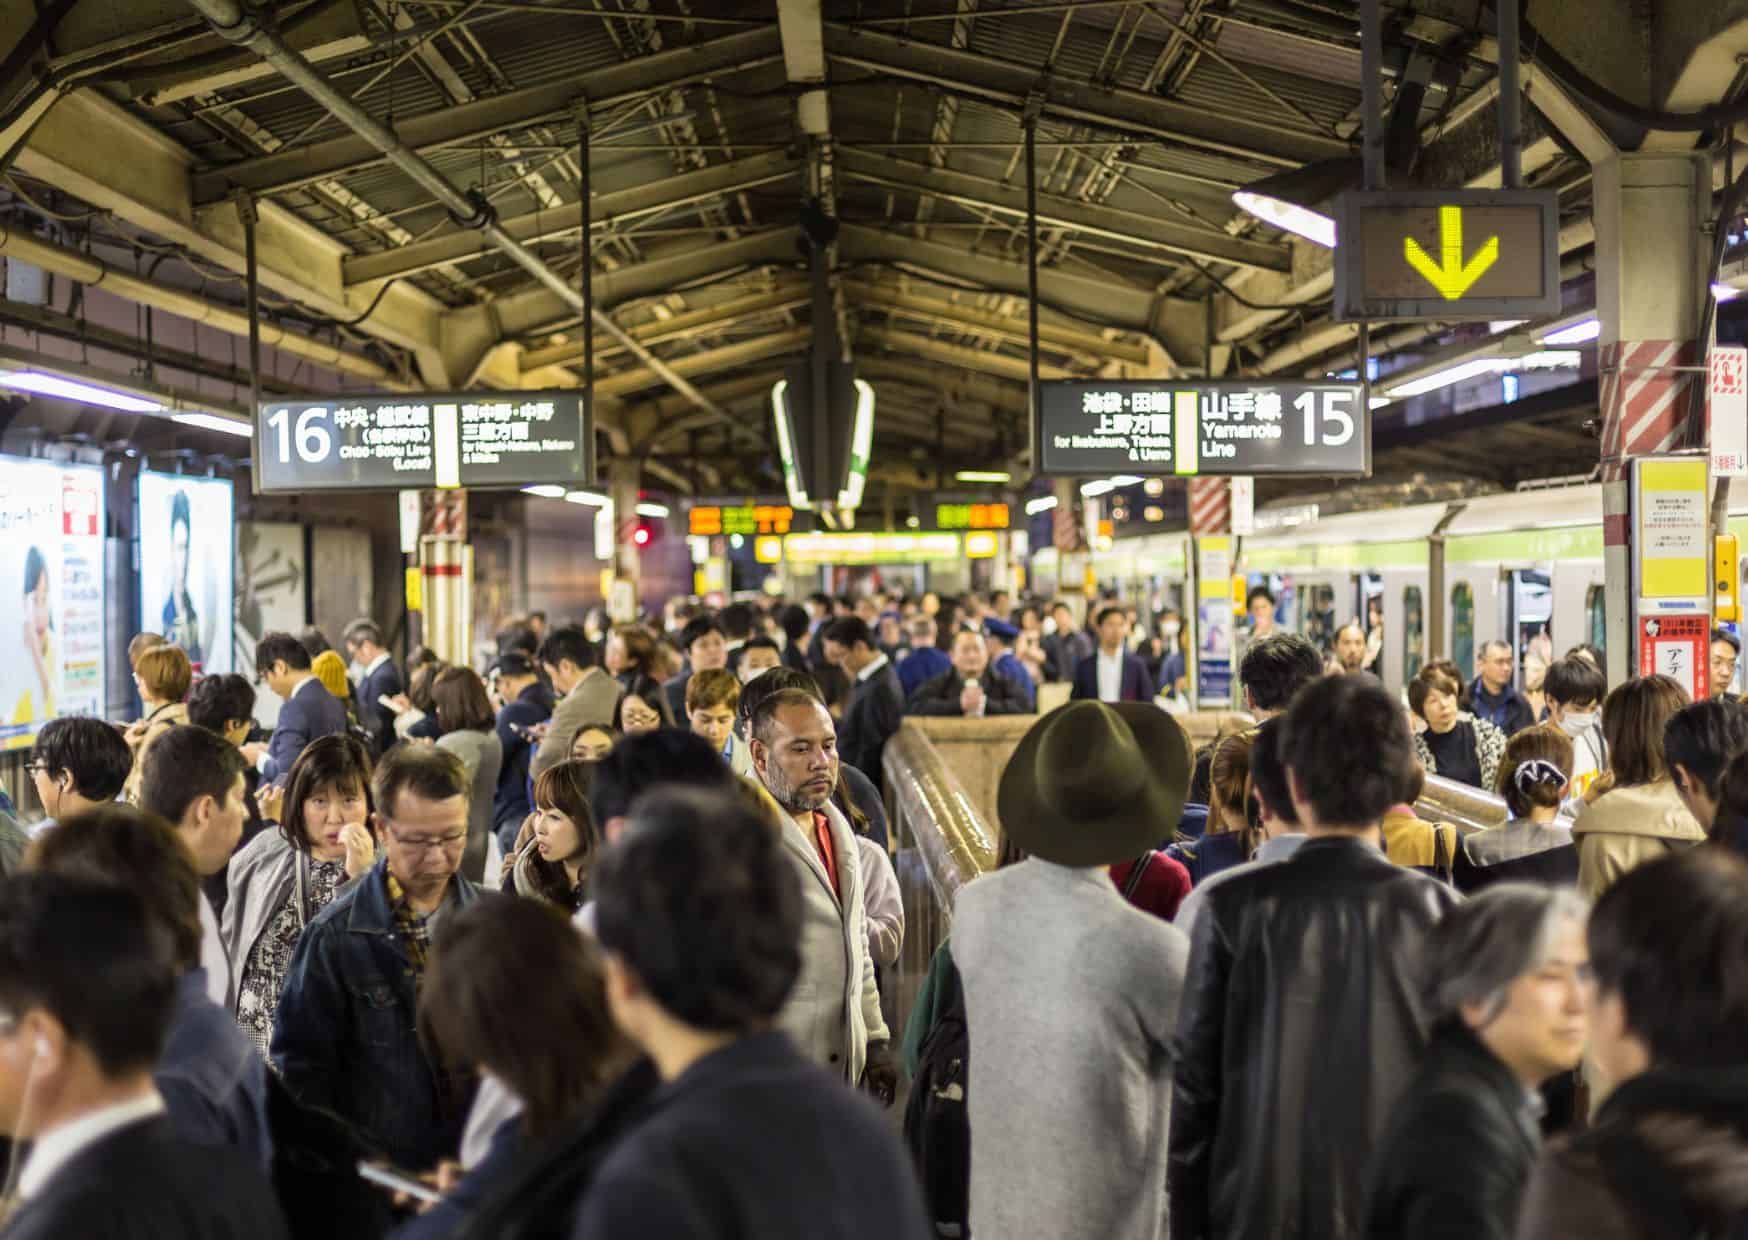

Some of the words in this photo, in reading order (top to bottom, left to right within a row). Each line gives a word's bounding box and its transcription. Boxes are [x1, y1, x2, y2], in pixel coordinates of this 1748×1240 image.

[1201, 392, 1282, 421] 山手線
[1293, 391, 1355, 446] 15
[268, 407, 331, 463] 16
[1202, 422, 1282, 439] Yamanote
[407, 444, 431, 456] Line
[1055, 436, 1070, 448] for
[1202, 441, 1236, 458] Line
